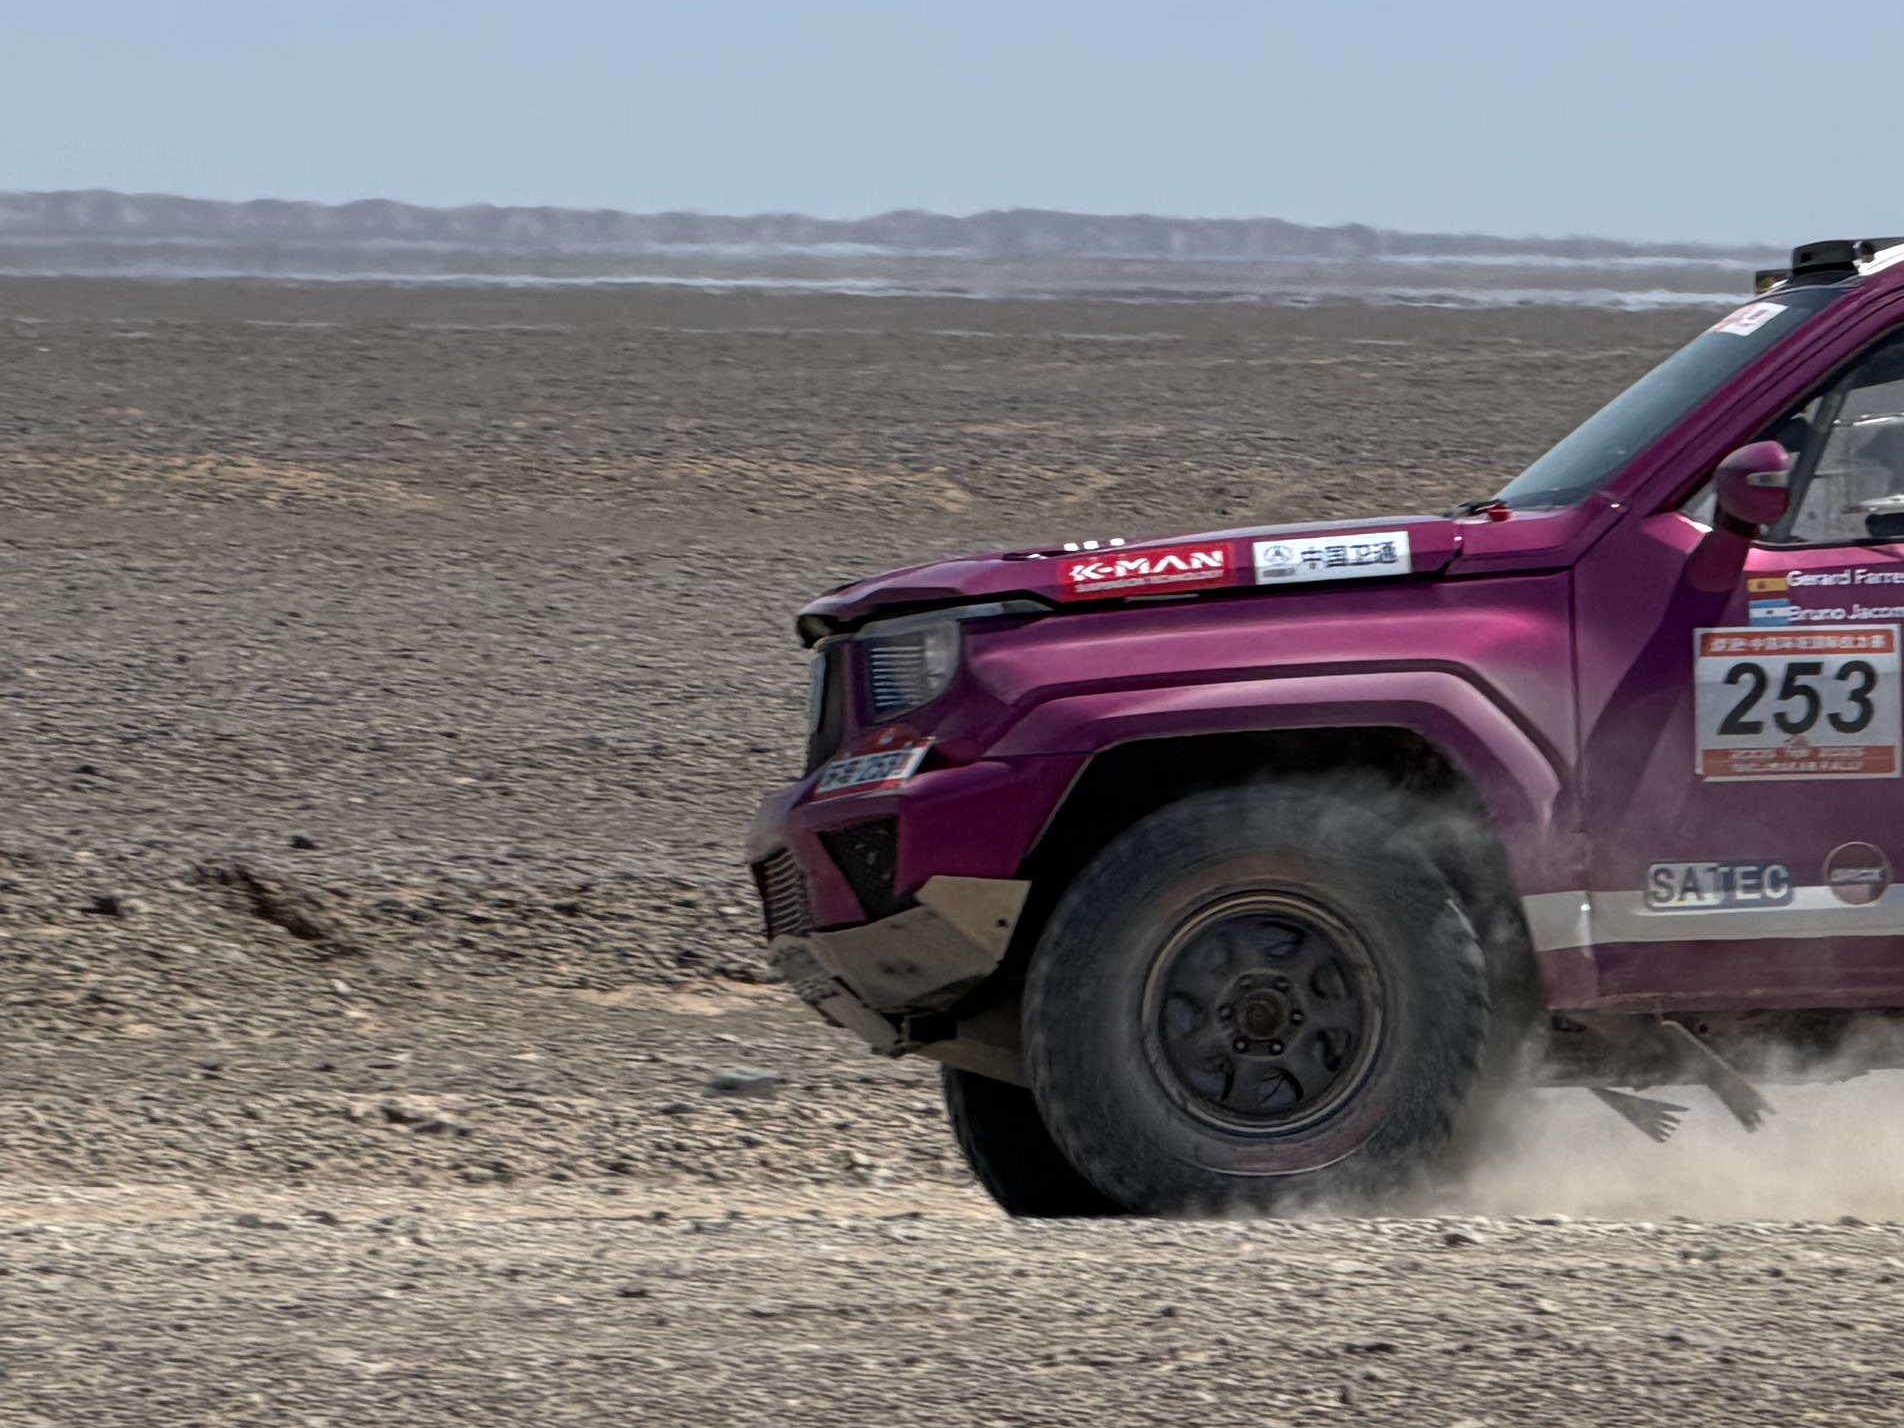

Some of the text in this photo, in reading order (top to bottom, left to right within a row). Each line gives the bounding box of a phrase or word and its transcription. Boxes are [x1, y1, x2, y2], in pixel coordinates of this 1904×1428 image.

[1069, 550, 1224, 581] K-MAN
[1787, 605, 1846, 621] Bruno
[1717, 660, 1877, 735] 253
[1649, 864, 1789, 904] SATEC
